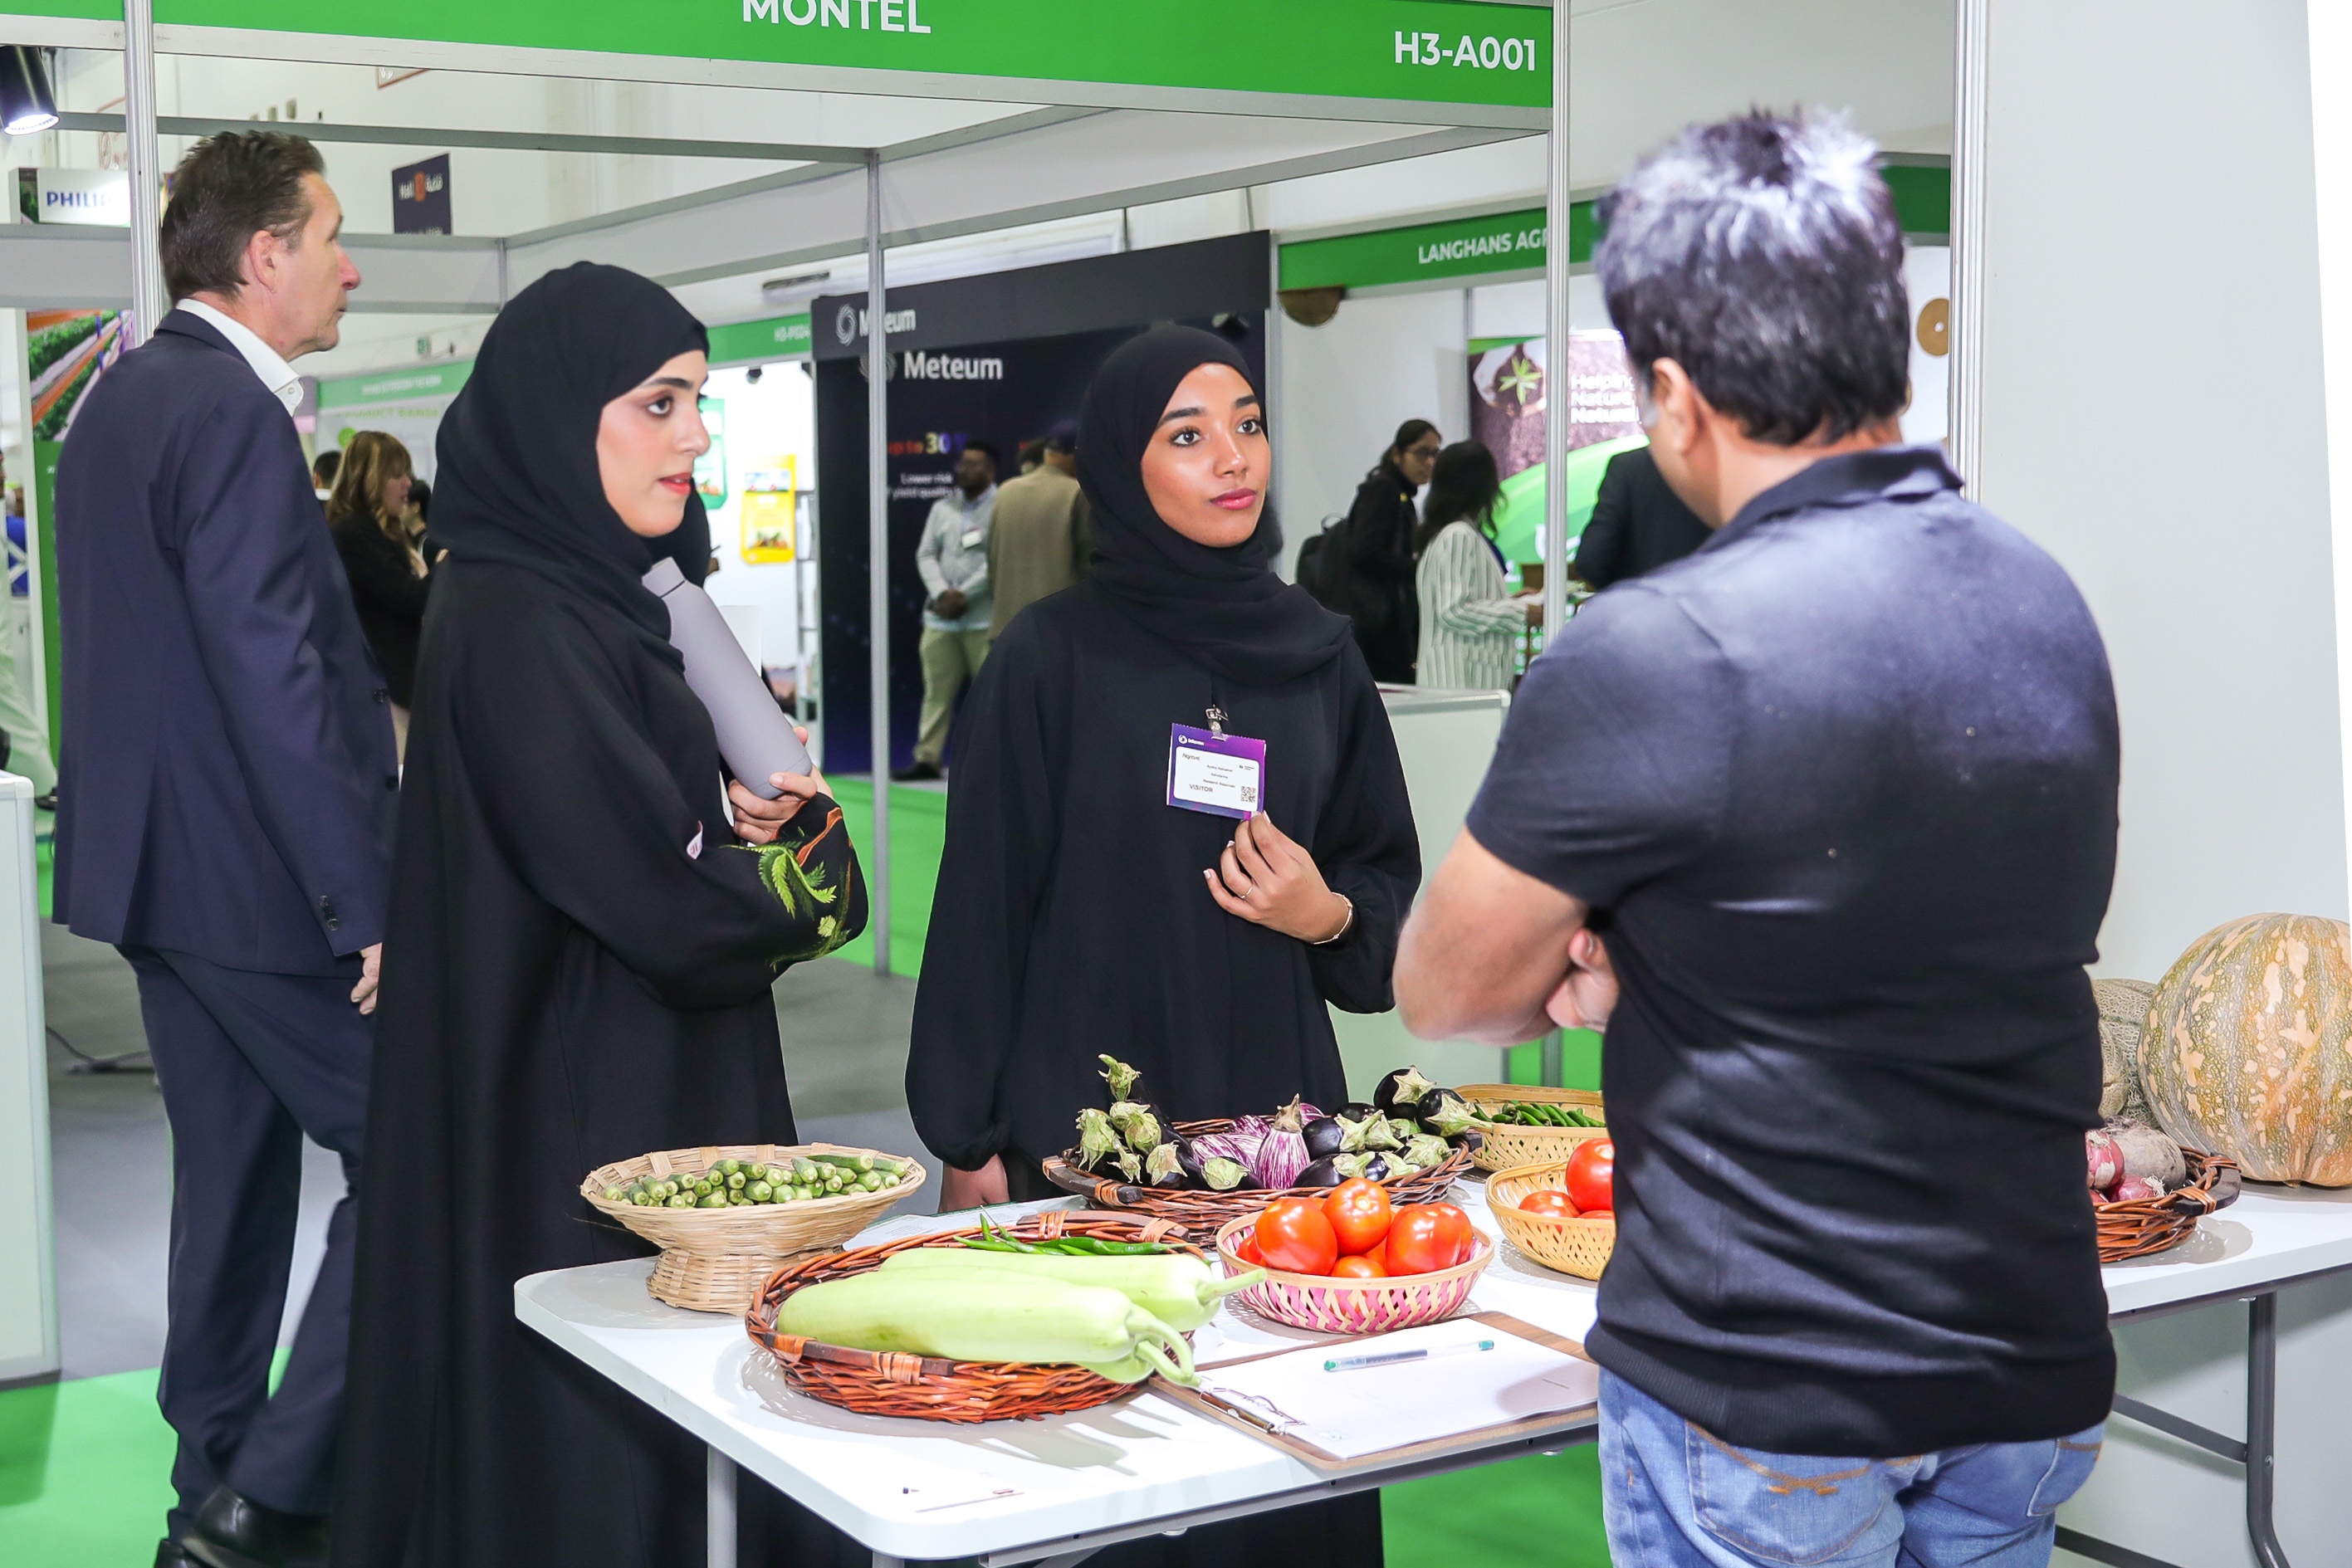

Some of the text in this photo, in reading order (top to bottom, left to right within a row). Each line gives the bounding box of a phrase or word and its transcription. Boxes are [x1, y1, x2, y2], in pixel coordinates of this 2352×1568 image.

[743, 0, 932, 34] MONTEL
[1395, 31, 1535, 71] H3-A001
[1419, 232, 1512, 265] LANGHANS
[859, 309, 917, 337] Meum
[903, 350, 1004, 380] Meteum
[1189, 784, 1214, 793] VISITOR
